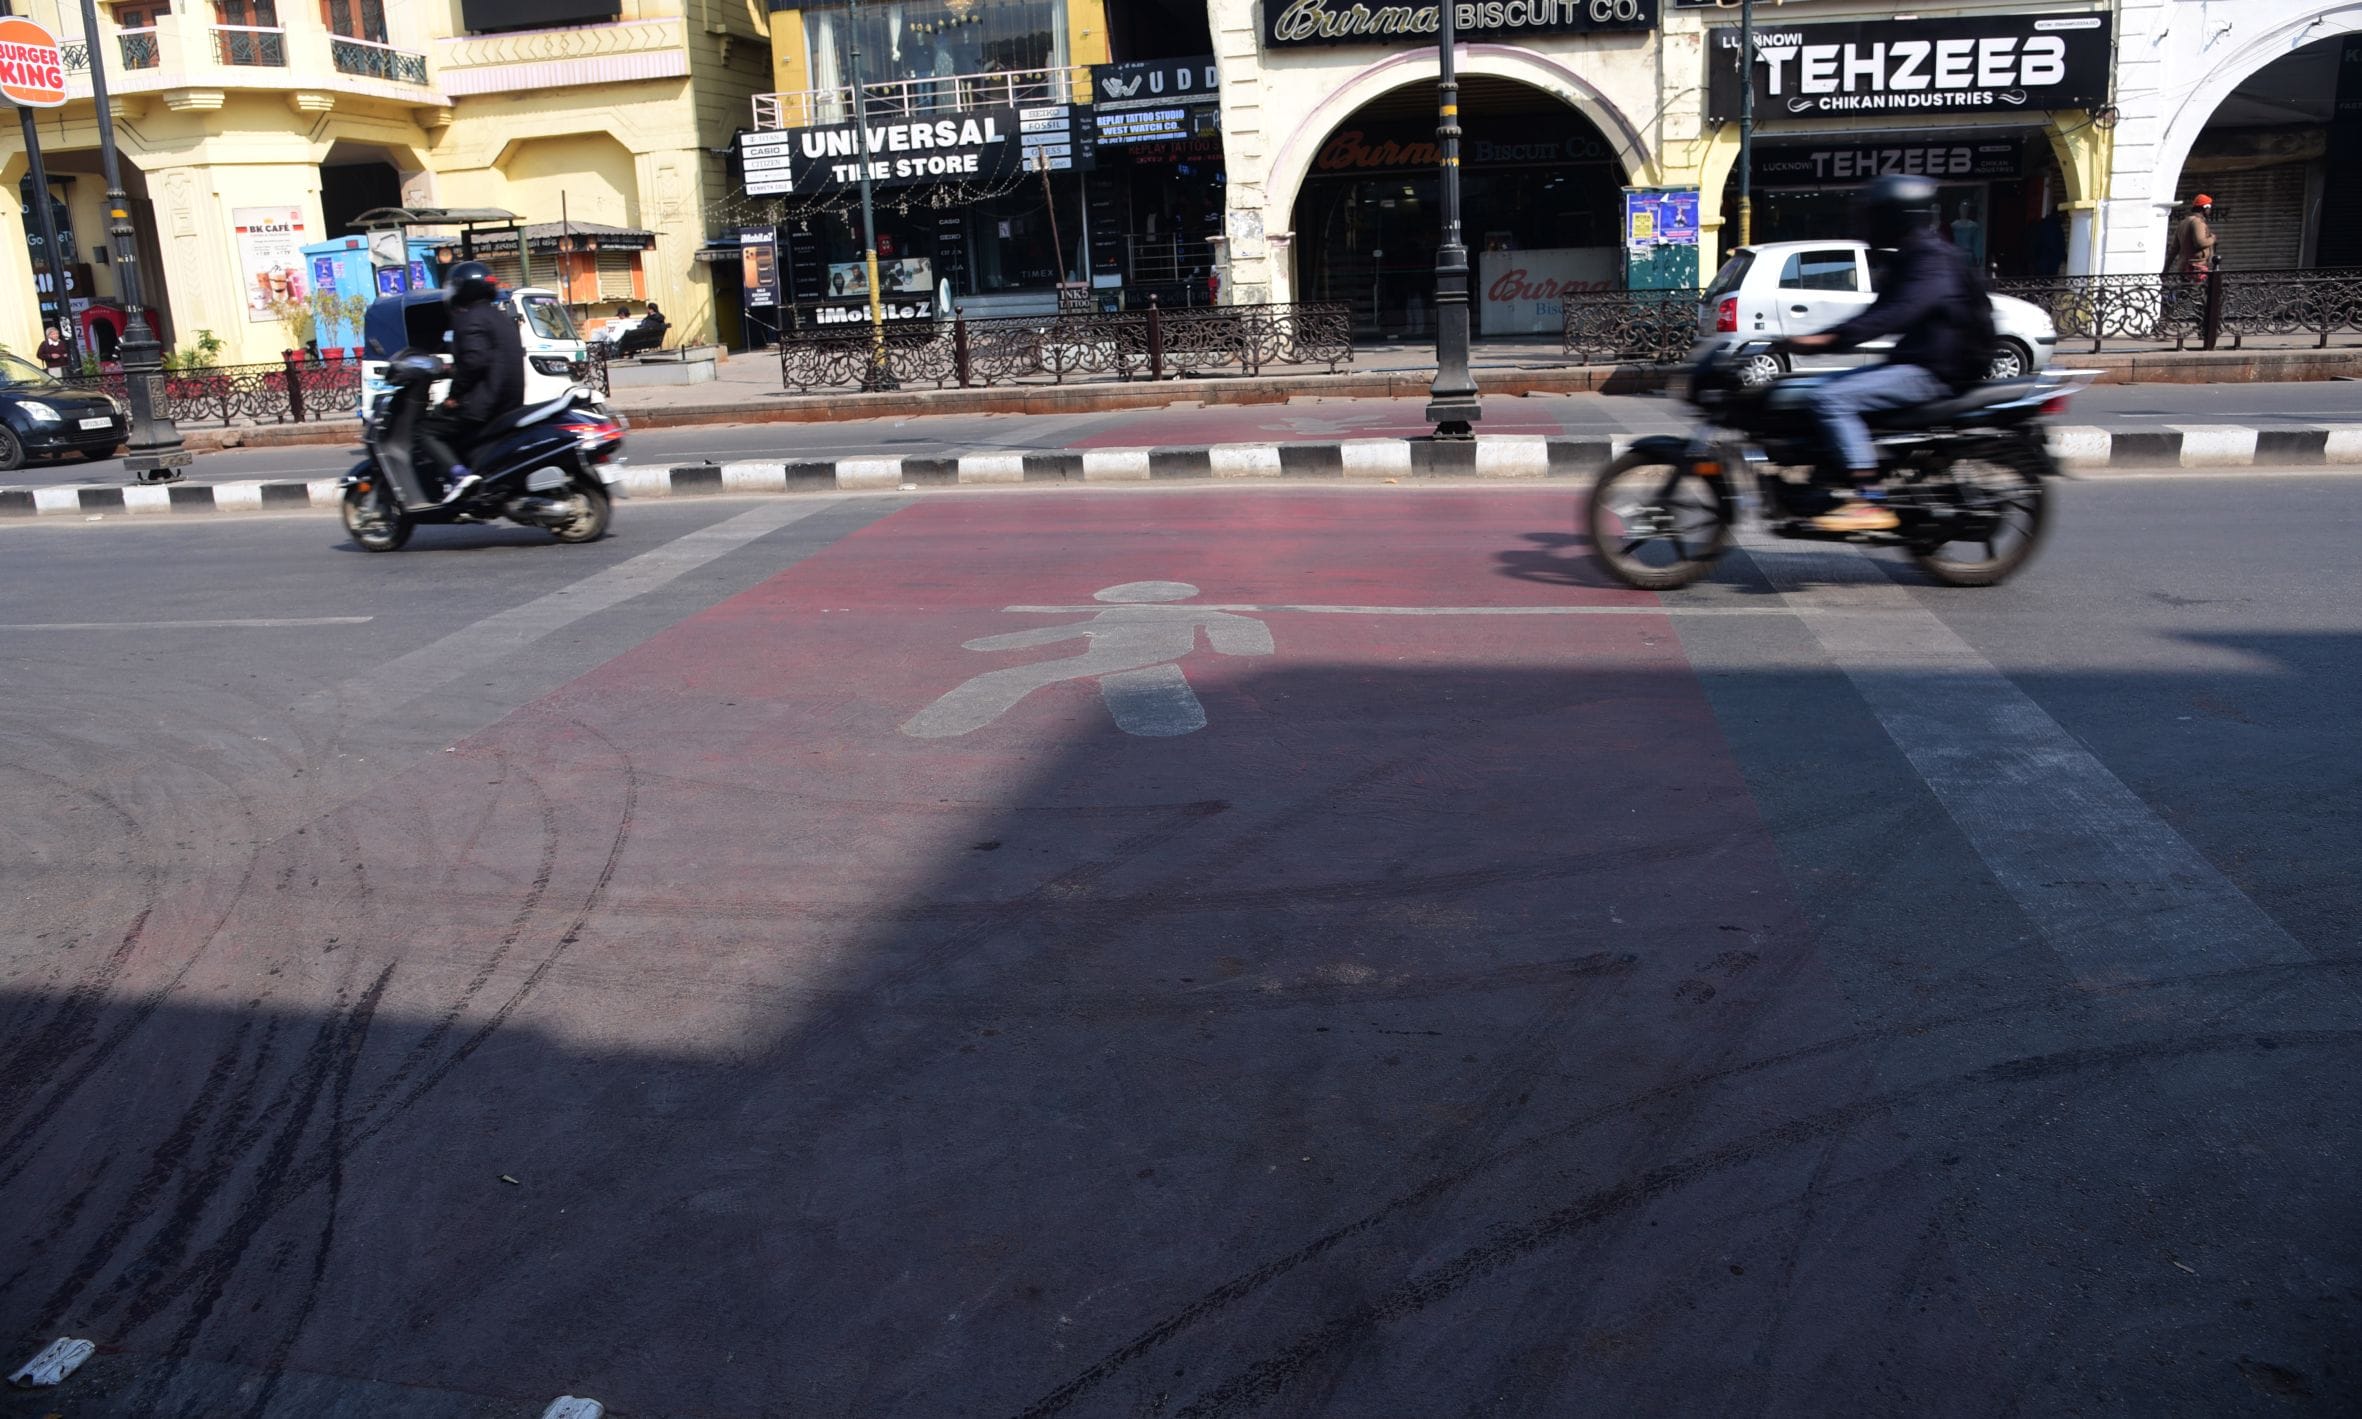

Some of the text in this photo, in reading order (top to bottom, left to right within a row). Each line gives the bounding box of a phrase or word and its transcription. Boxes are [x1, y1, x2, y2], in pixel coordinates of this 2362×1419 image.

[1275, 0, 1645, 40] Burma BISCUIT CO.
[0, 43, 59, 66] BURGER
[0, 60, 63, 89] KING
[1755, 36, 2066, 95] TEHZEEB
[1819, 91, 1993, 110] CHIKAN INDUSTRIES
[1029, 121, 1061, 130] FOSSIL
[1097, 115, 1124, 127] REPLAY
[1126, 112, 1154, 124] TATTOO
[1155, 109, 1184, 120] STUDIO
[802, 117, 1005, 159] UNIVERSAL
[1103, 125, 1128, 136] WEST
[1130, 122, 1162, 133] WATCH
[750, 147, 780, 155] CASIO
[1031, 147, 1062, 156] GESS
[896, 154, 978, 177] STORE
[1763, 147, 1972, 177] LUCKNOWI TEHZEEB
[249, 222, 290, 233] BK CAFÉ
[1021, 268, 1054, 278] TIMEX
